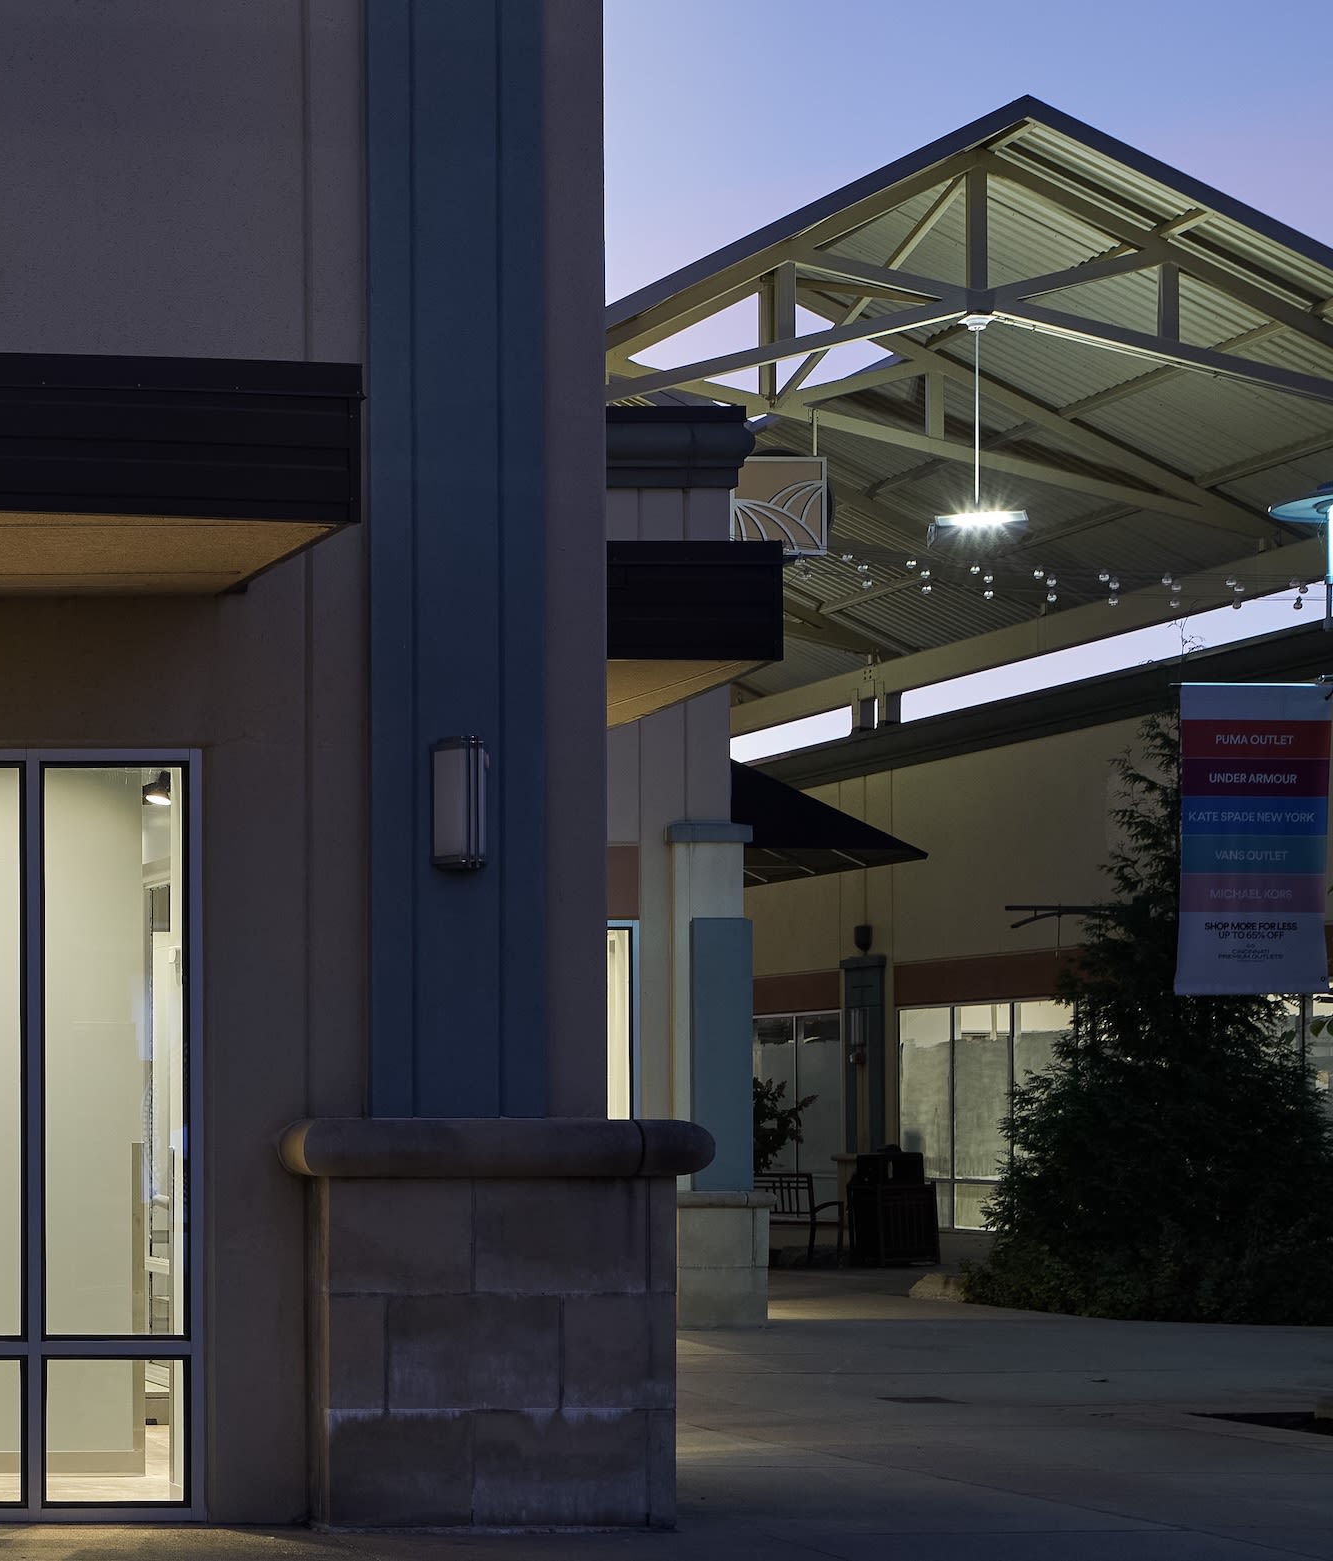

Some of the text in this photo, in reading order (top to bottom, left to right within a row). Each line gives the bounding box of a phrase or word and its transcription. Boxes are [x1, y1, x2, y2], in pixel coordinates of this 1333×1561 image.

[1215, 734, 1294, 745] PUMA OUTLET
[1209, 772, 1298, 784] UNDER ARMOUR
[1188, 812, 1315, 823] KATE SPADE NEW YORK
[1214, 850, 1289, 861] VANS OUTLET
[1209, 888, 1293, 900] MICHAEL KORS
[1204, 922, 1298, 931] SHOP MORE FOR LESS
[1218, 931, 1285, 940] UP TO 65% OFF
